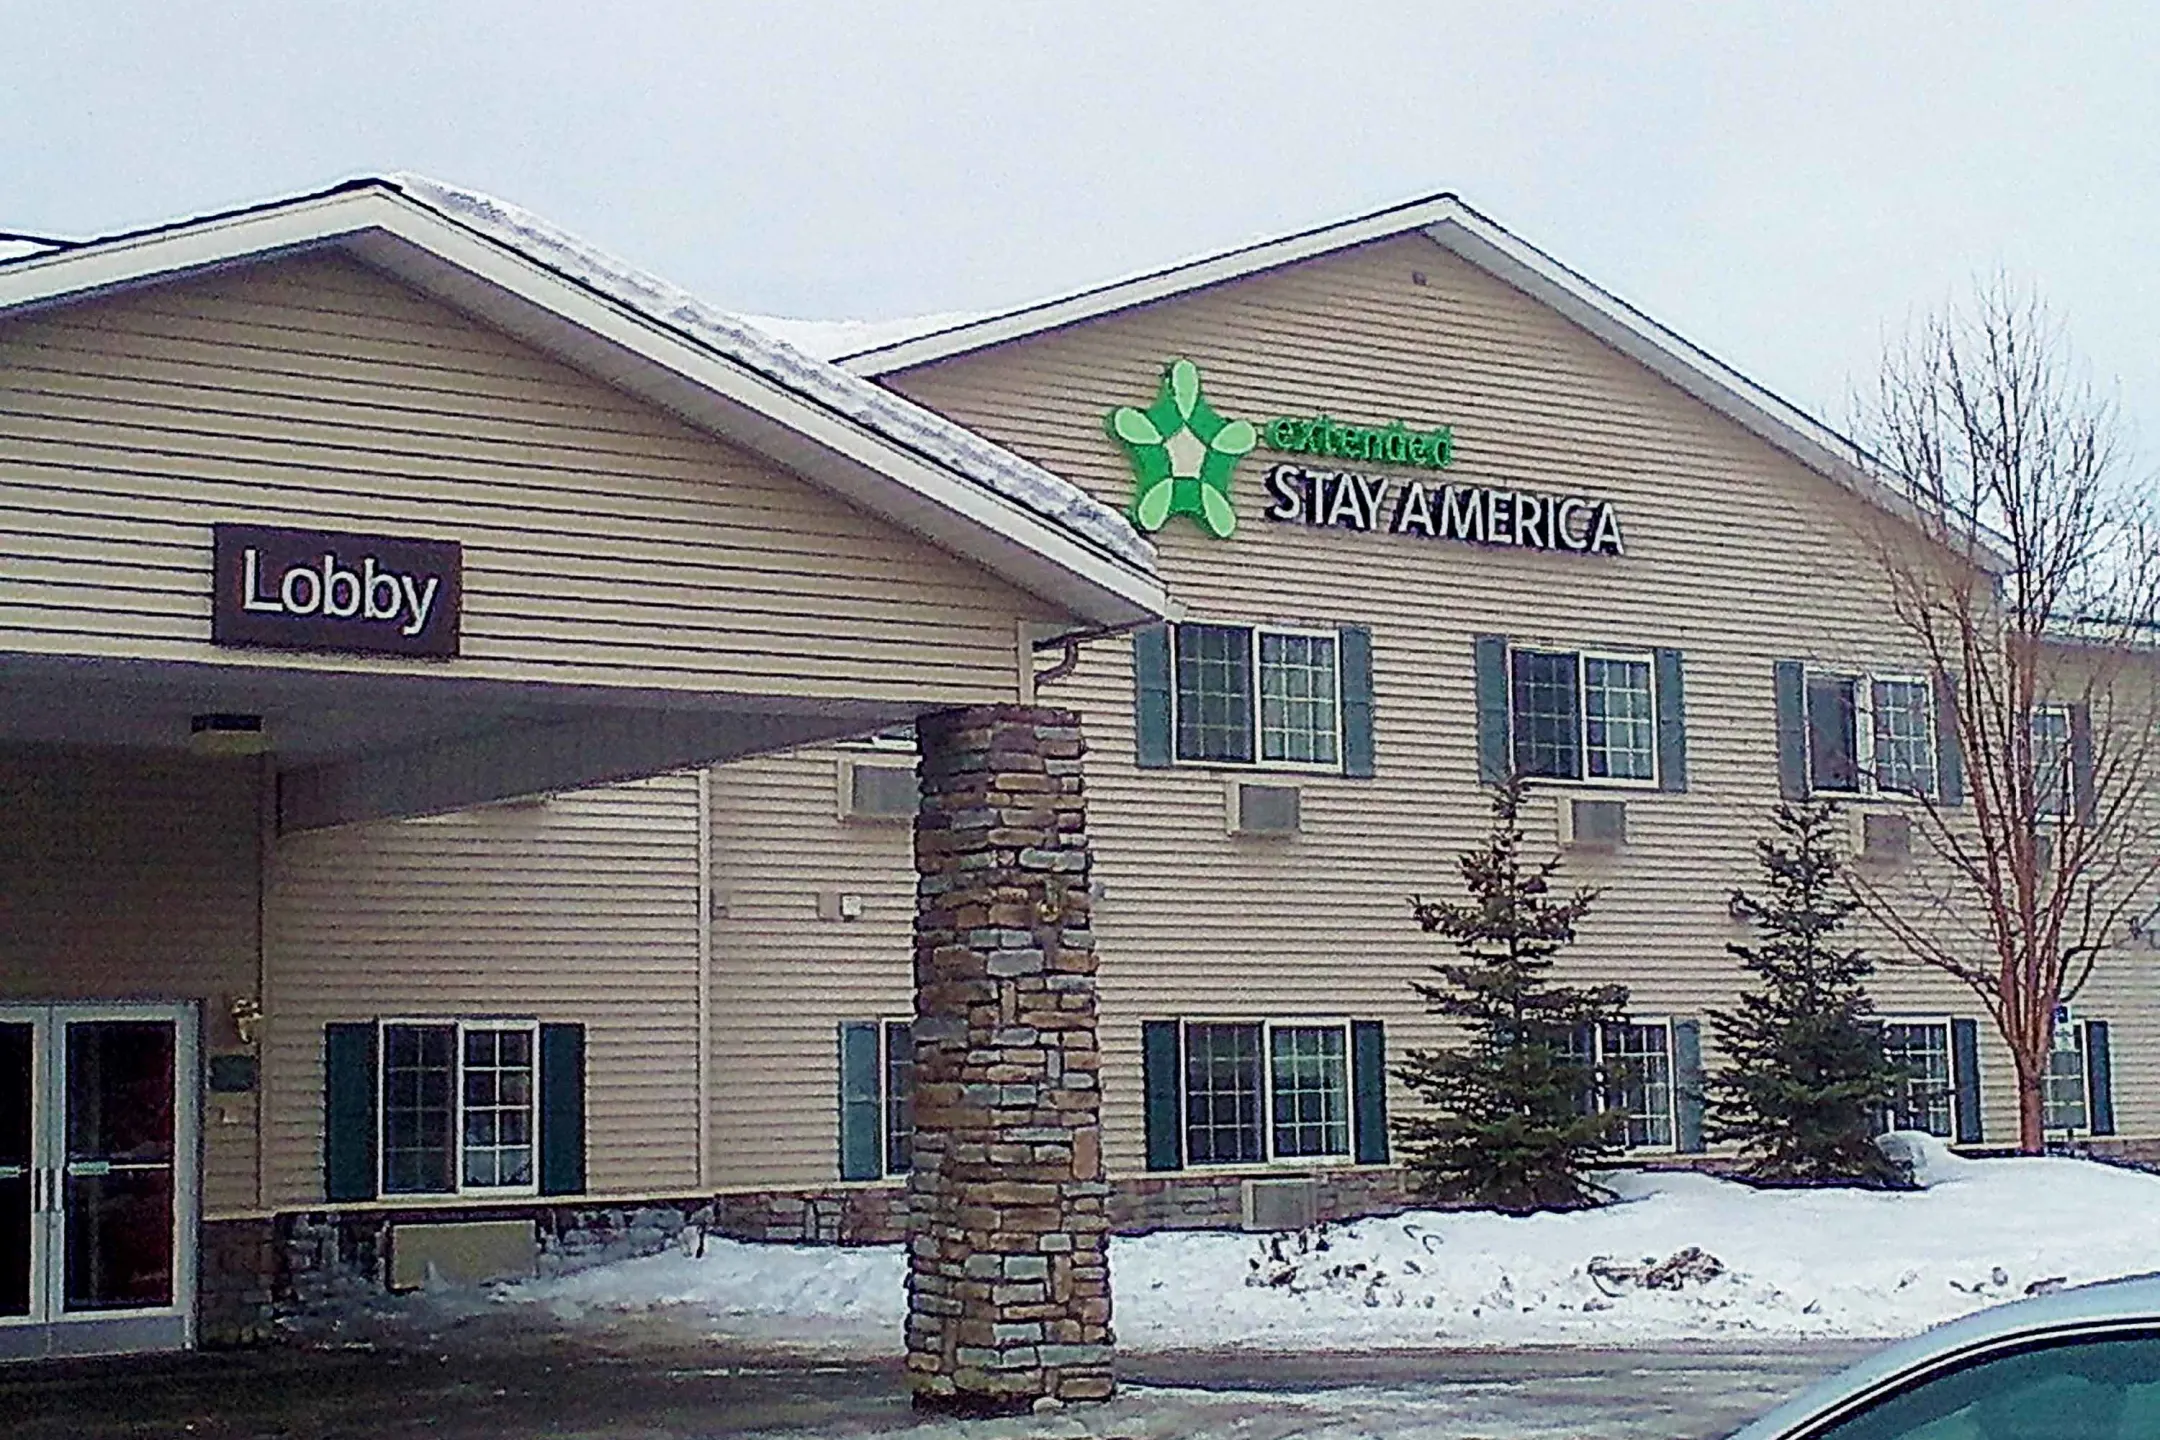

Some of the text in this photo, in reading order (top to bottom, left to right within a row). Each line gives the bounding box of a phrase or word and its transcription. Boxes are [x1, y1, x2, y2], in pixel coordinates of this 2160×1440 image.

[1273, 416, 1453, 470] extended
[1273, 464, 1625, 555] STAY AMERICA
[243, 548, 438, 636] Lobby
